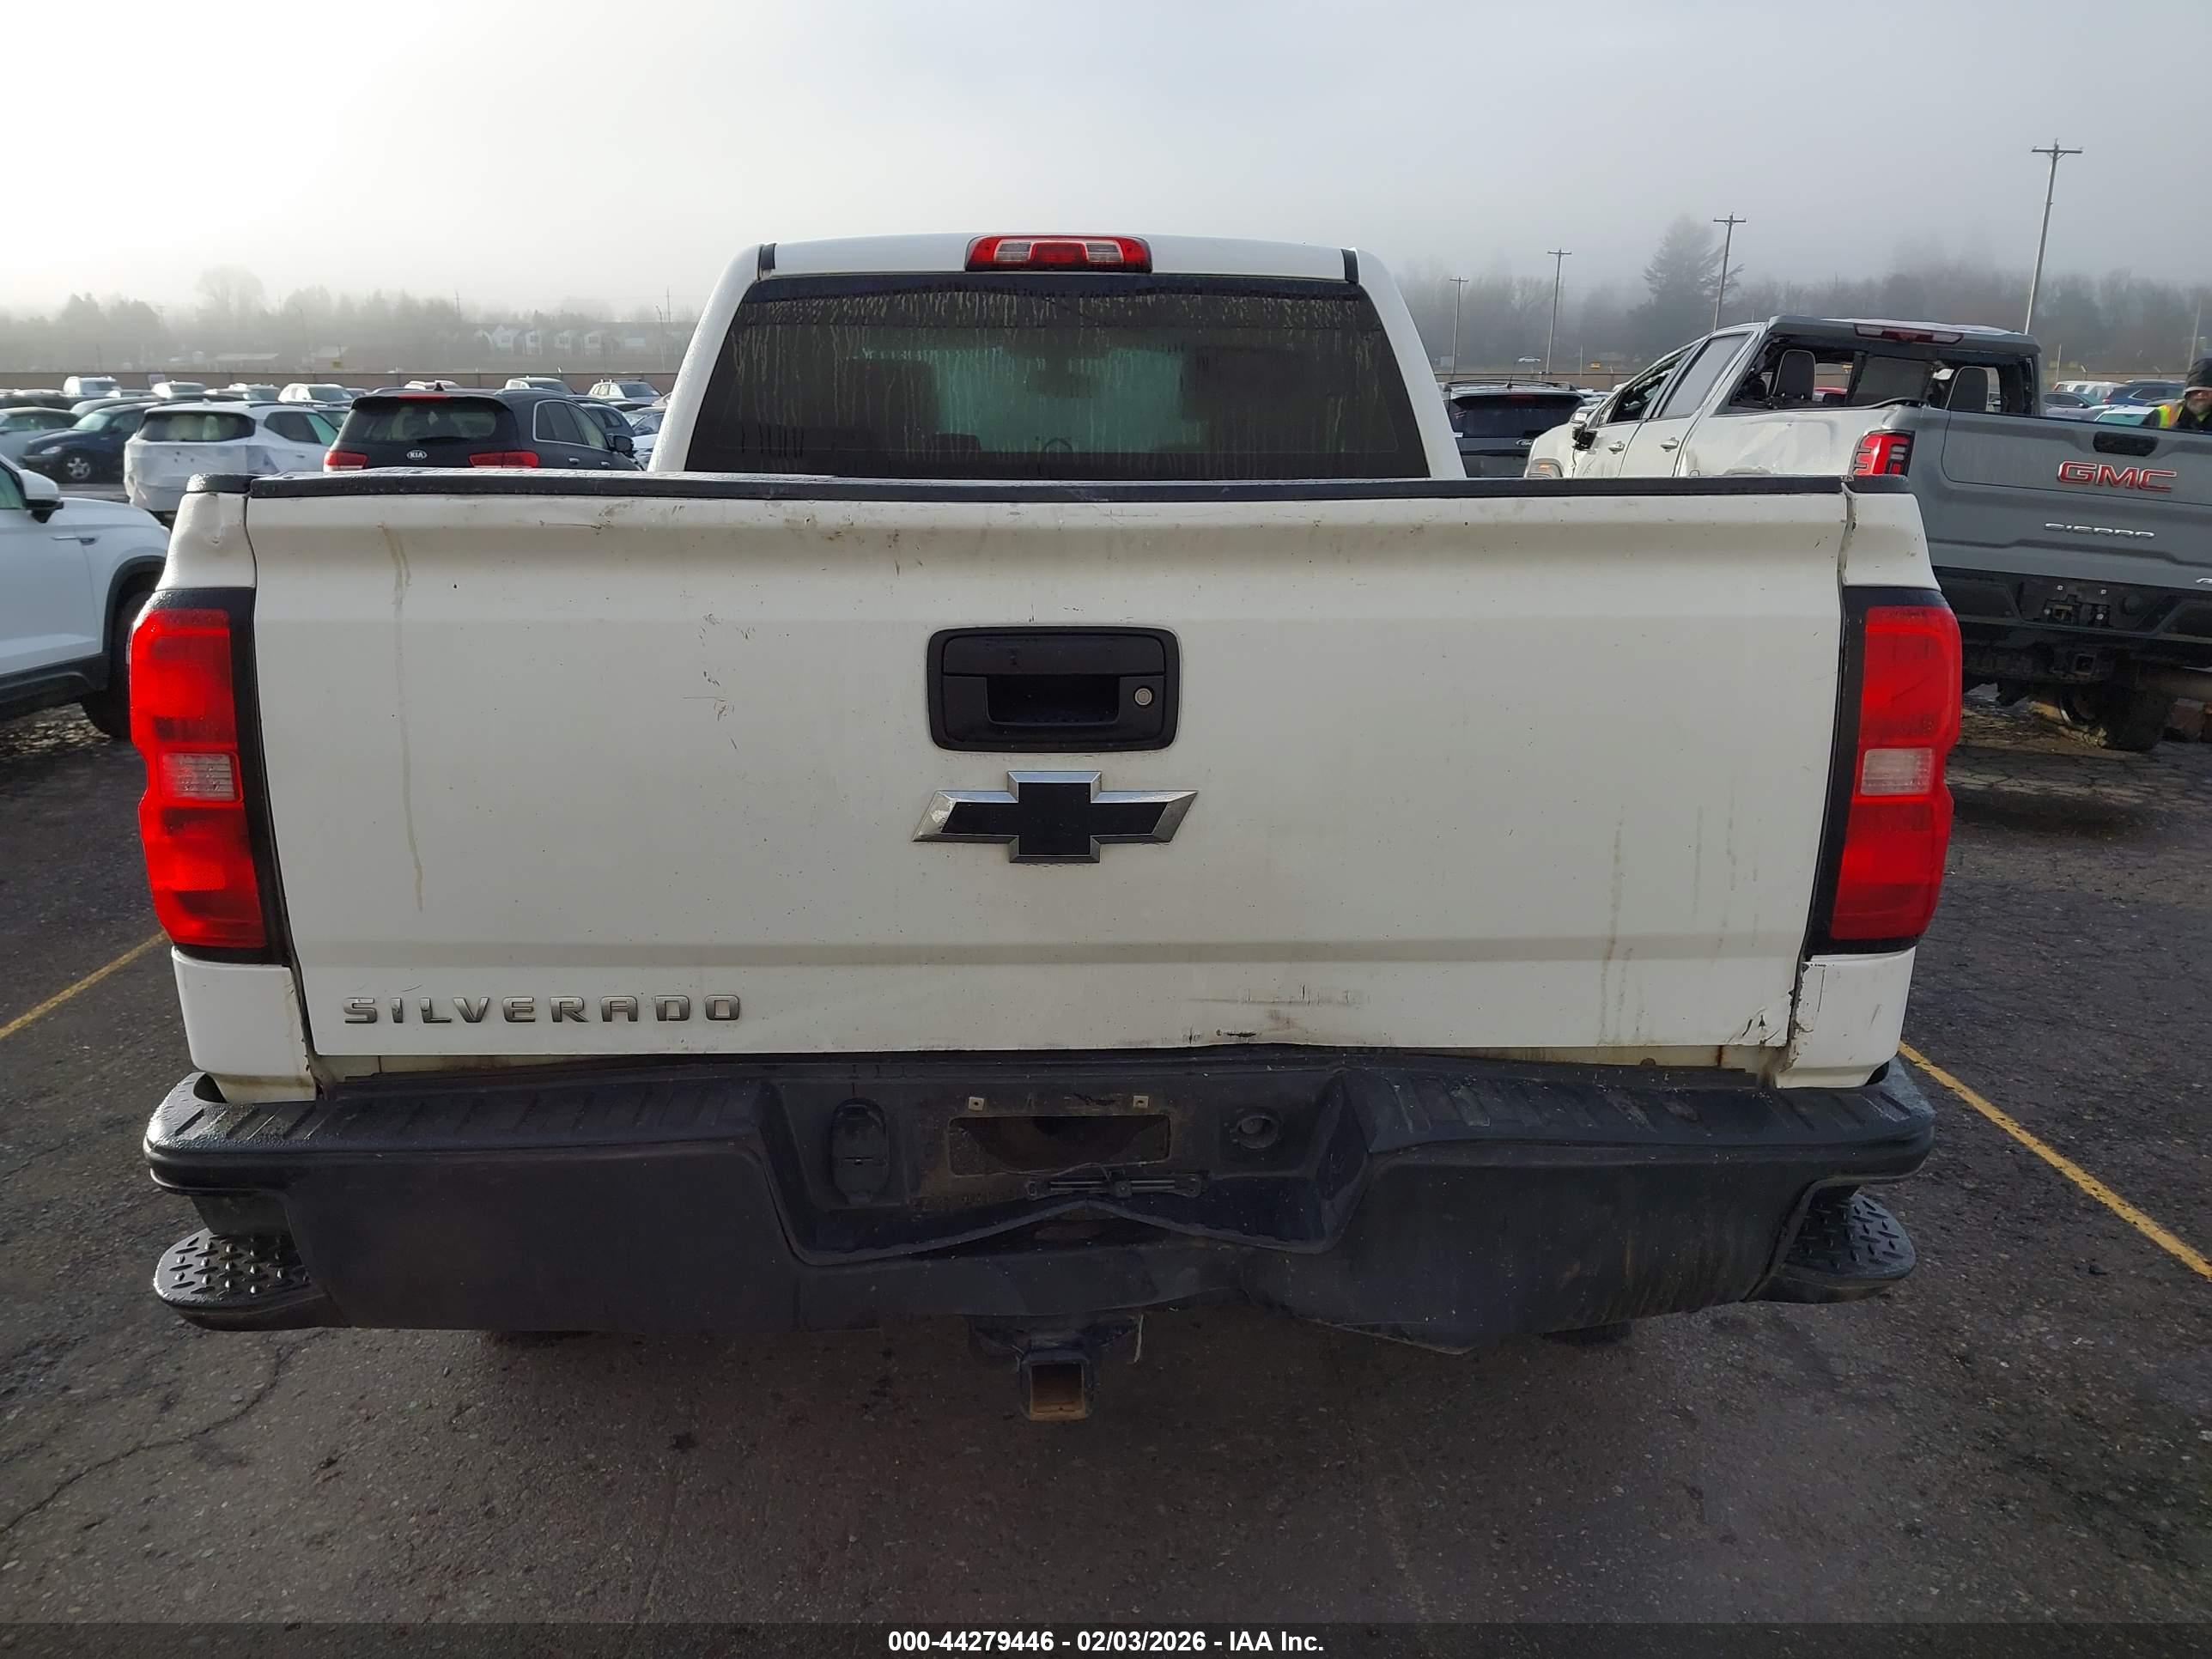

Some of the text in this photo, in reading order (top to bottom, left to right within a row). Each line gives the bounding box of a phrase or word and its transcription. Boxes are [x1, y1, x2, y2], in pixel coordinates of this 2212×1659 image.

[2057, 460, 2177, 493] GMC
[2045, 523, 2155, 538] SIERRA
[343, 994, 741, 1024] SILVERADO
